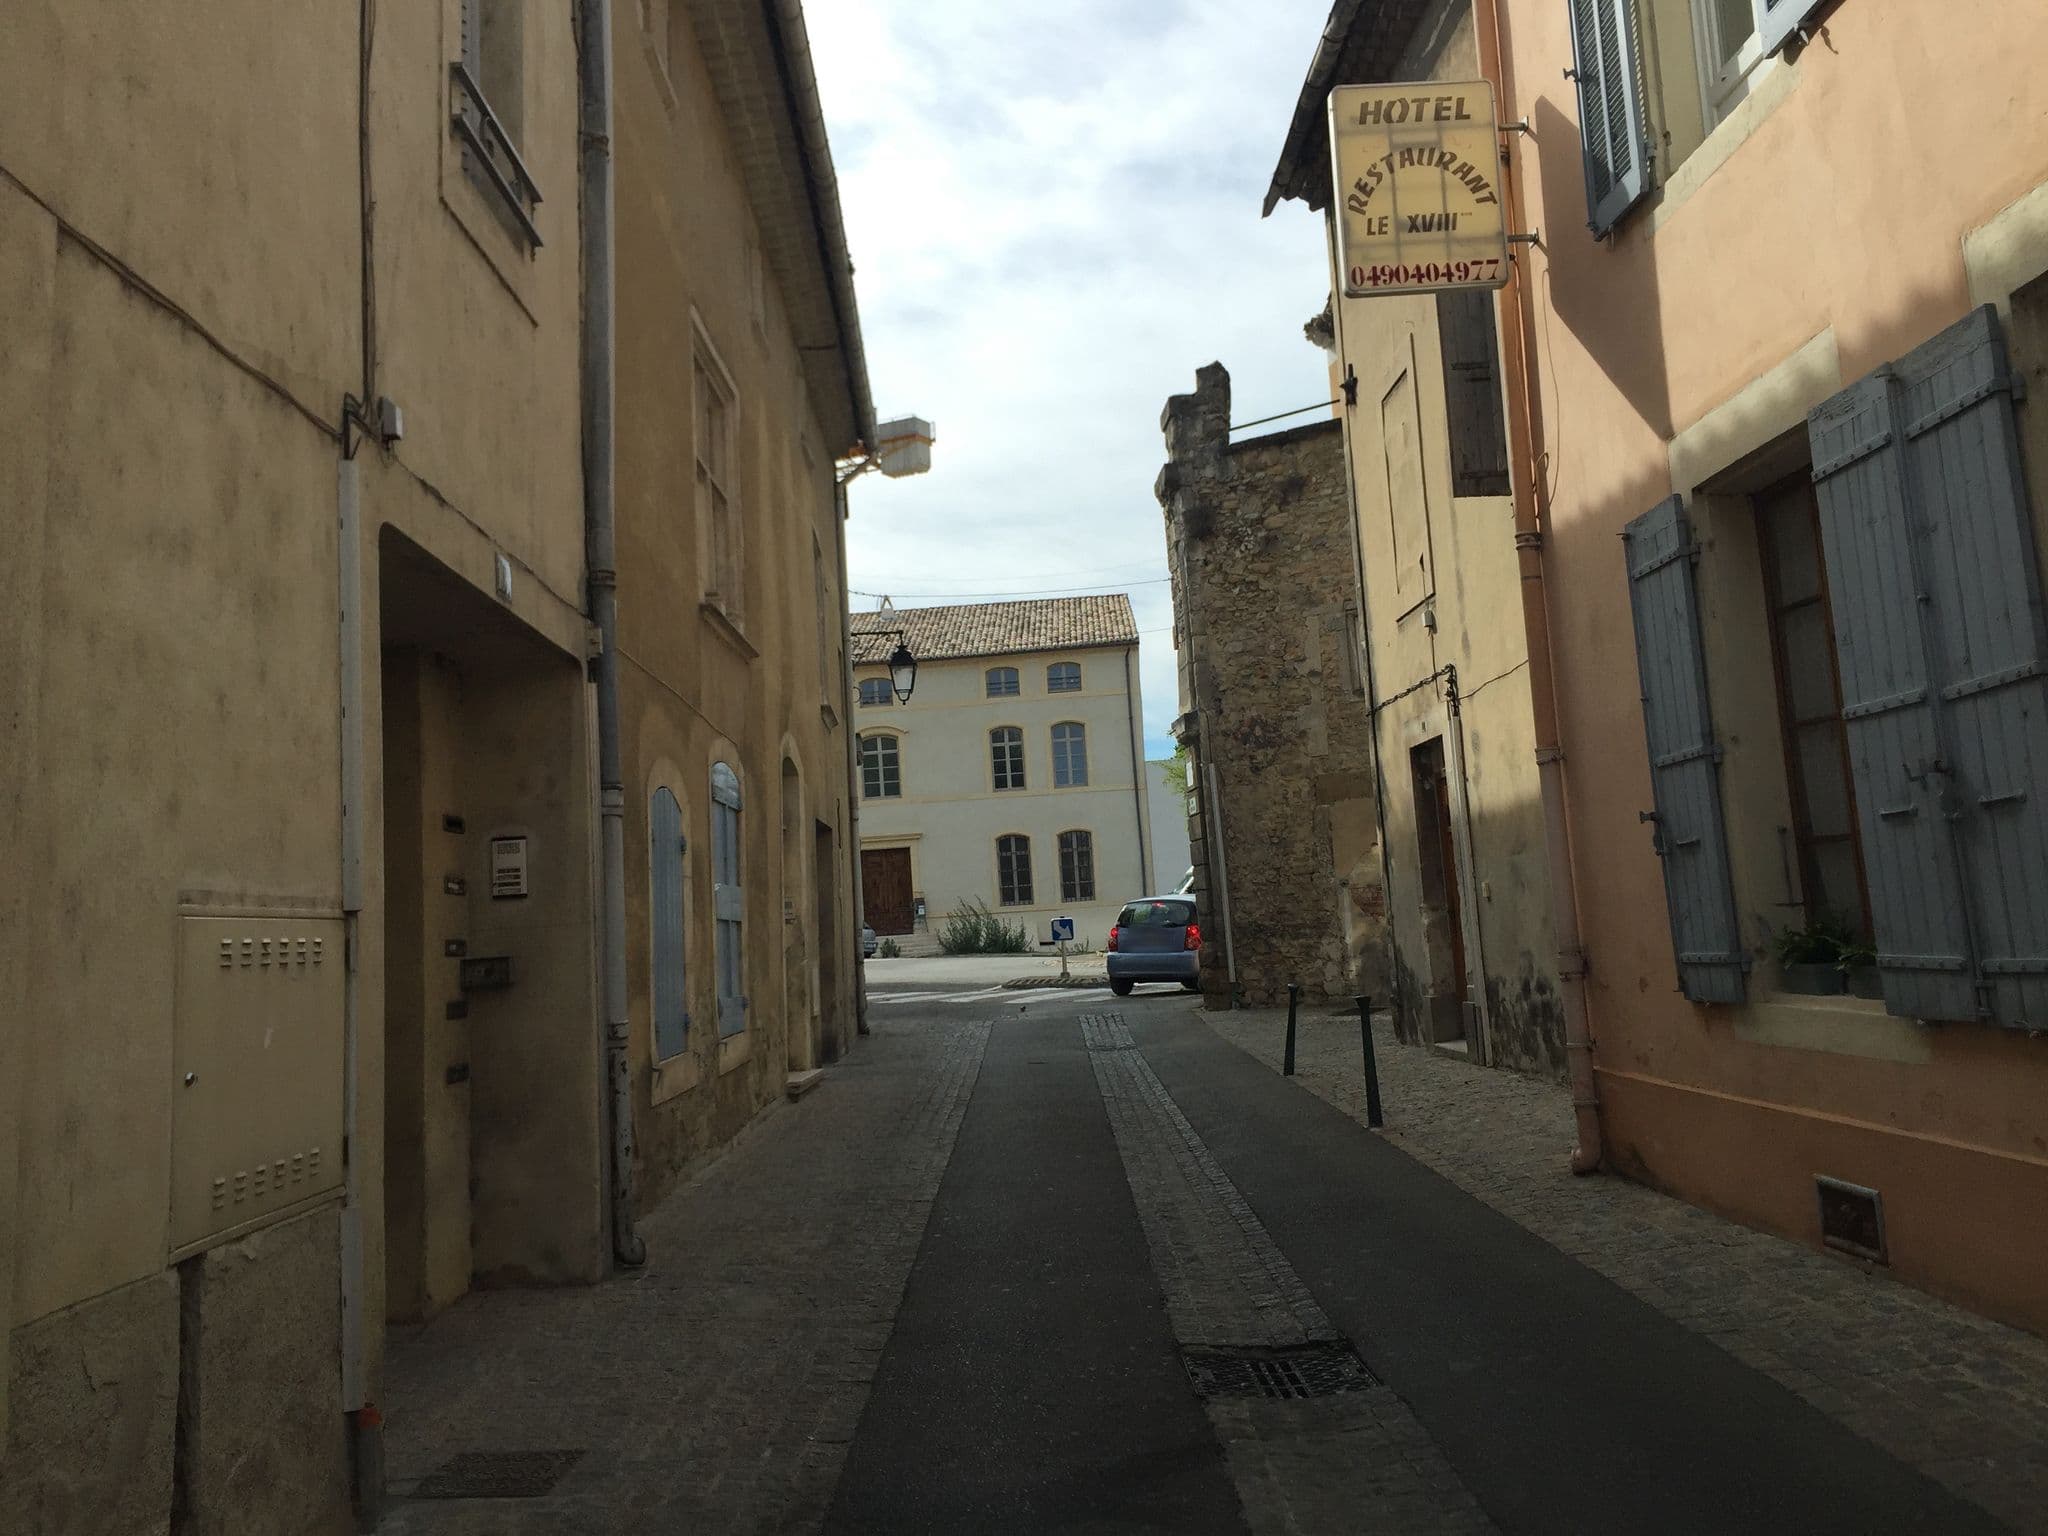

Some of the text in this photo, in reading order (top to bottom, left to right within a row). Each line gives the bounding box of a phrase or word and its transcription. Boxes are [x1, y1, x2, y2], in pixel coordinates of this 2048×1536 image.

[1358, 96, 1471, 125] HOTEL
[1348, 147, 1498, 216] RESTAURANT
[1366, 212, 1458, 236] LE XVIII
[1351, 259, 1499, 287] 0490404977
